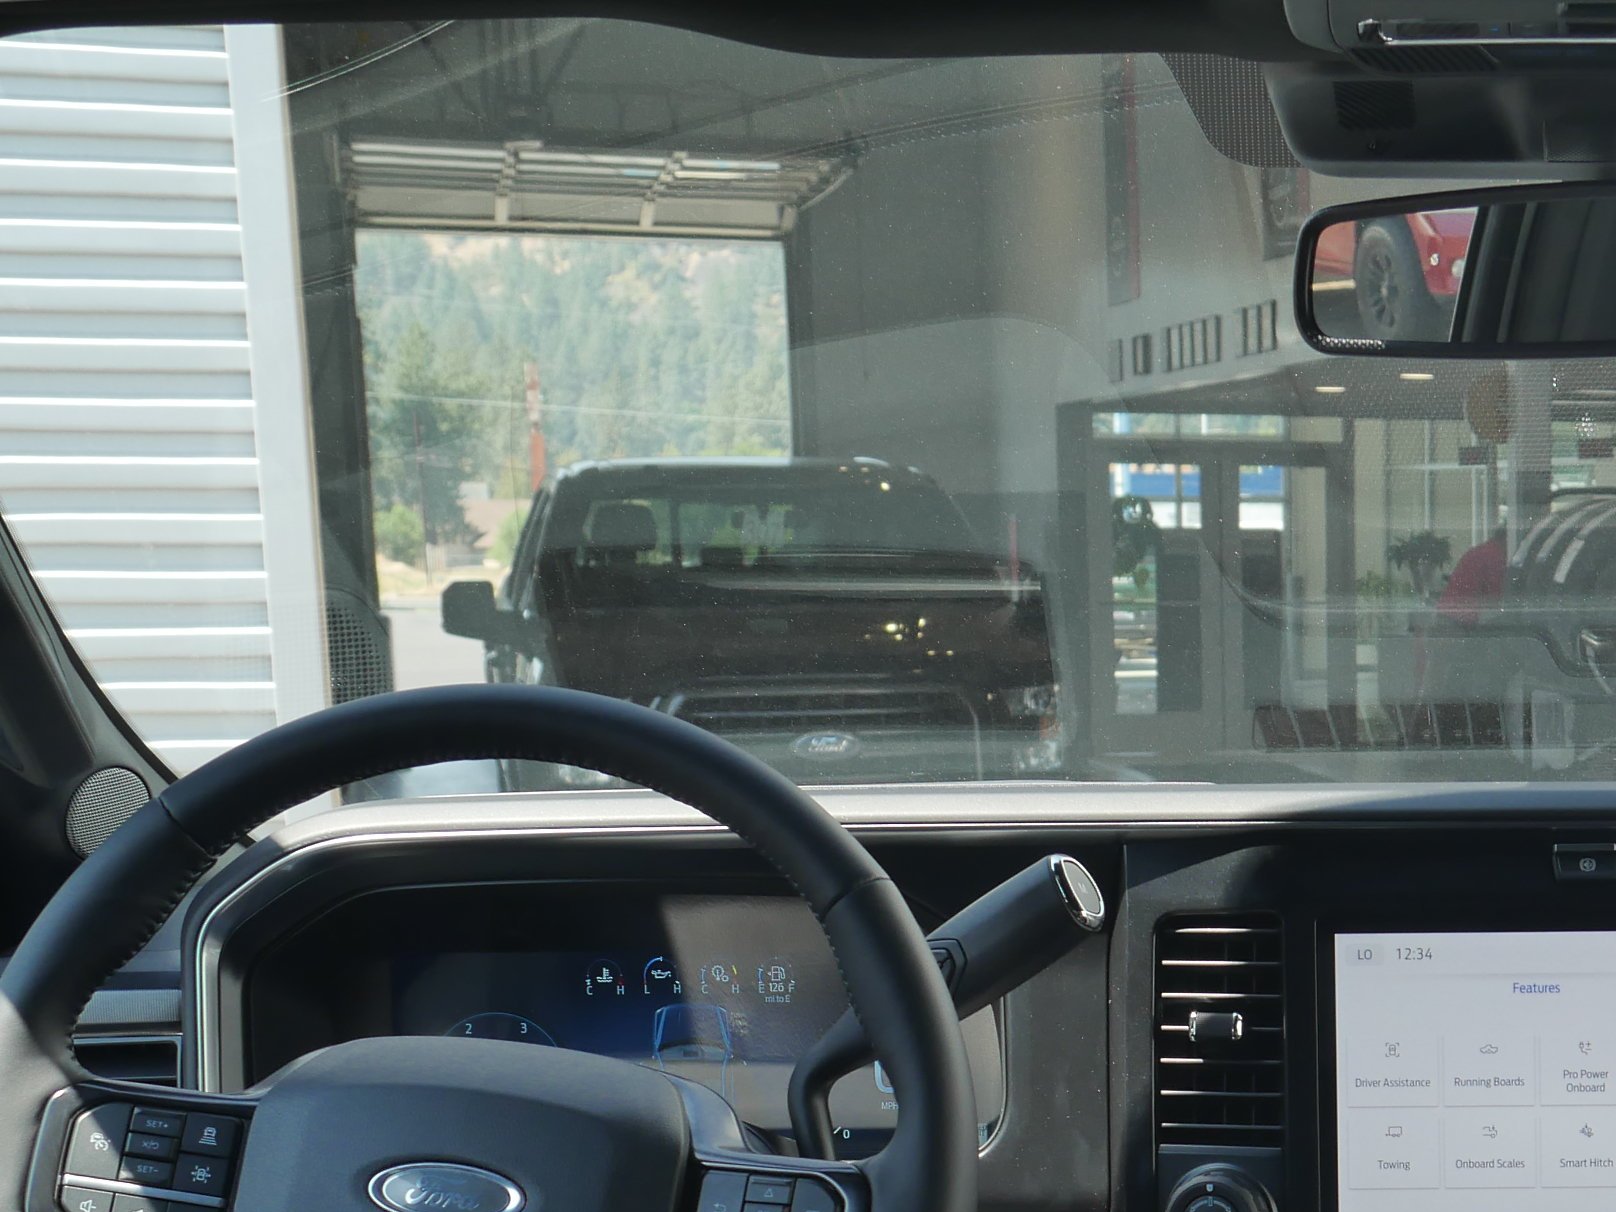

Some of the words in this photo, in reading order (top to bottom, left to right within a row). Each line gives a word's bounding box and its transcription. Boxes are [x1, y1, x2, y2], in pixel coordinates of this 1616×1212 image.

[1356, 948, 1373, 961] LO
[1395, 947, 1433, 960] 12:34
[616, 985, 625, 995] H
[1512, 982, 1561, 994] Features
[465, 1023, 472, 1034] 2
[520, 1022, 527, 1034] 3
[1563, 1069, 1578, 1079] Pro
[1580, 1069, 1609, 1079] Power
[1355, 1078, 1381, 1088] Driver
[1383, 1078, 1431, 1087] Assistance
[1454, 1077, 1492, 1088] Running
[1494, 1077, 1525, 1087] Boards
[1566, 1083, 1605, 1093] Onboard
[146, 1119, 168, 1128] SET+
[843, 1129, 850, 1139] 0
[1377, 1159, 1411, 1171] Towing
[1455, 1159, 1495, 1169] Onboard
[1497, 1159, 1525, 1169] Scales
[1560, 1158, 1587, 1168] Smart
[1589, 1158, 1614, 1167] Hitch
[404, 1174, 480, 1211] Ford
